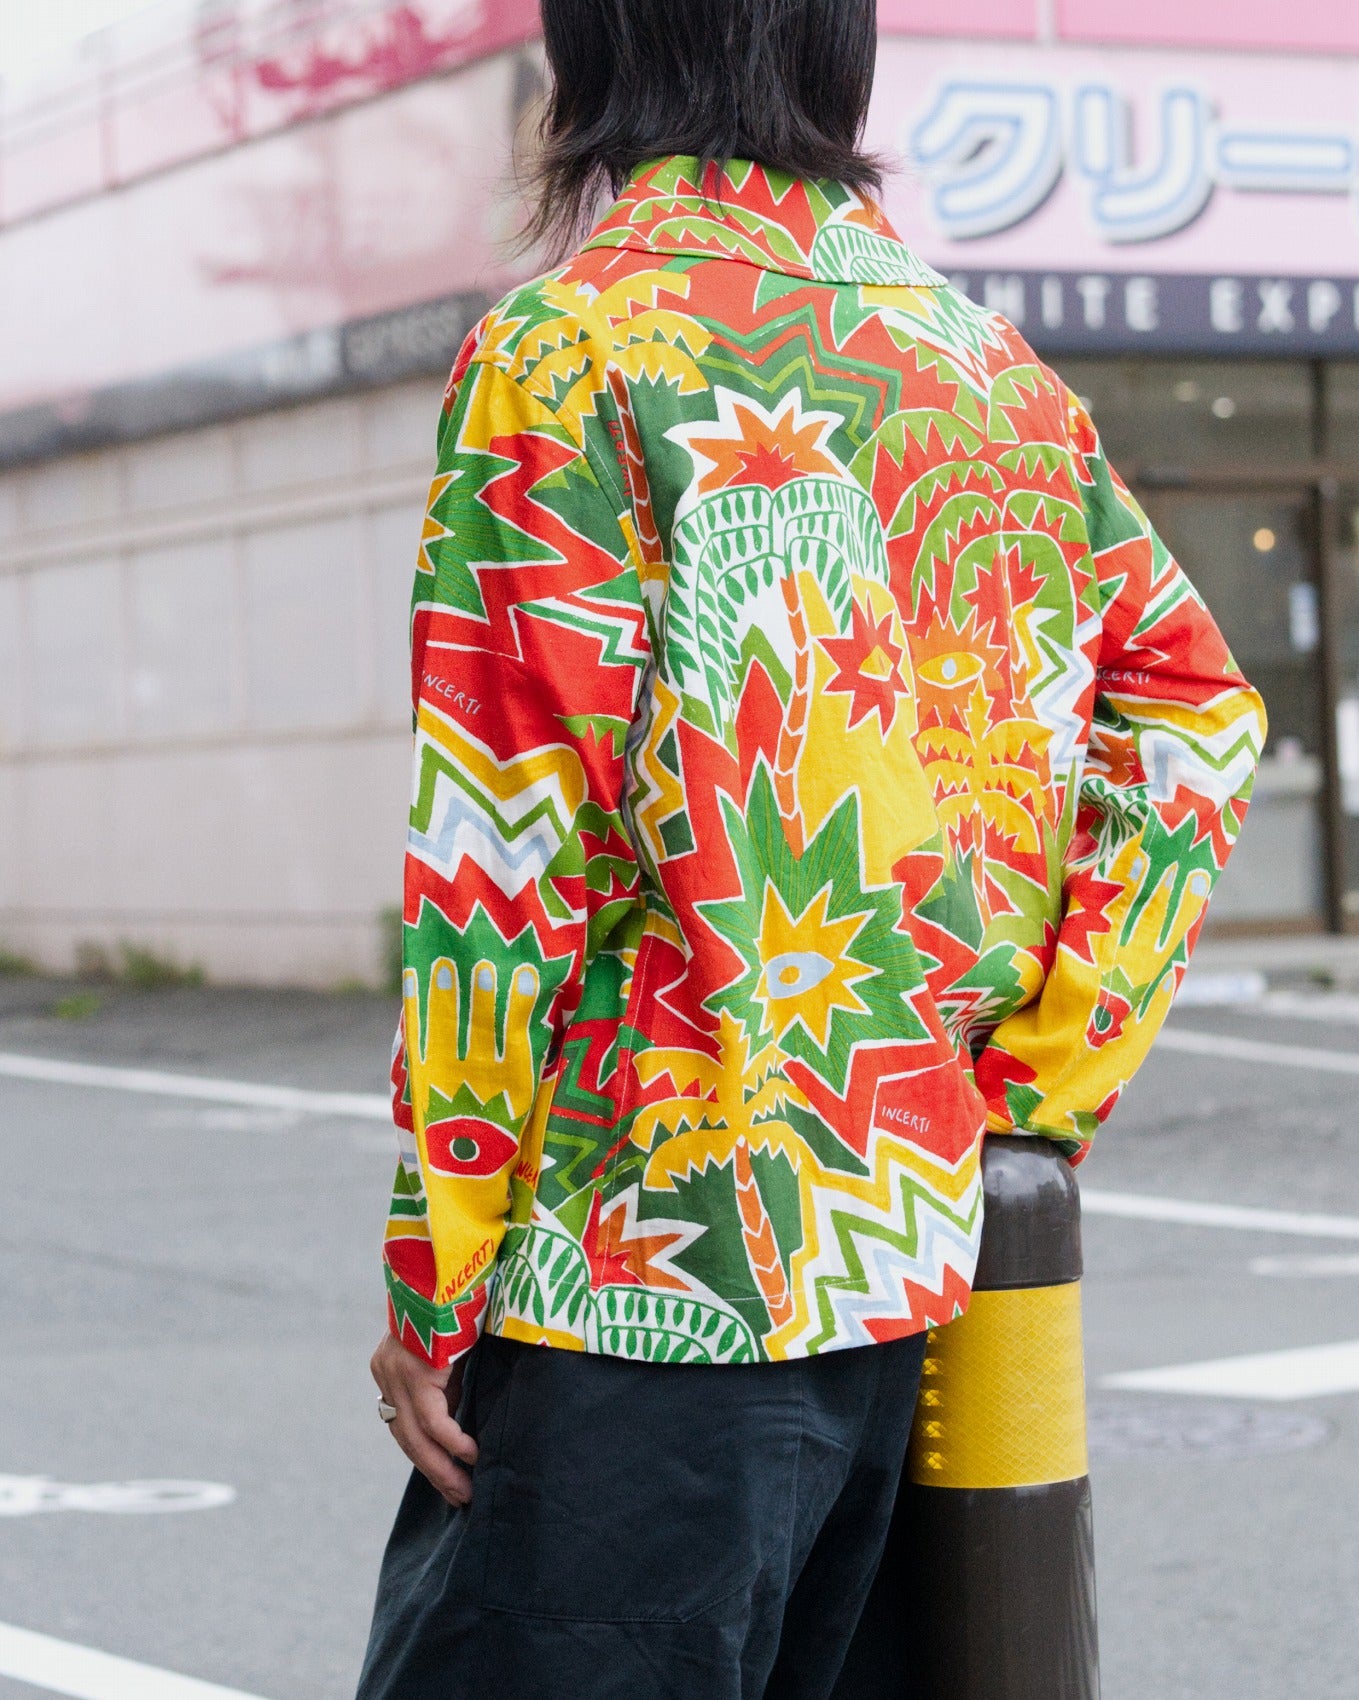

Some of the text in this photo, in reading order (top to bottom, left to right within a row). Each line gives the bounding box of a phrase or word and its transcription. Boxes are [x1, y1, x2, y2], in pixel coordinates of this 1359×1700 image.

[909, 79, 1359, 240] クリー
[945, 275, 1359, 333] HITE EXP
[881, 1104, 931, 1134] INCERTI
[441, 1238, 495, 1304] INCERTI
